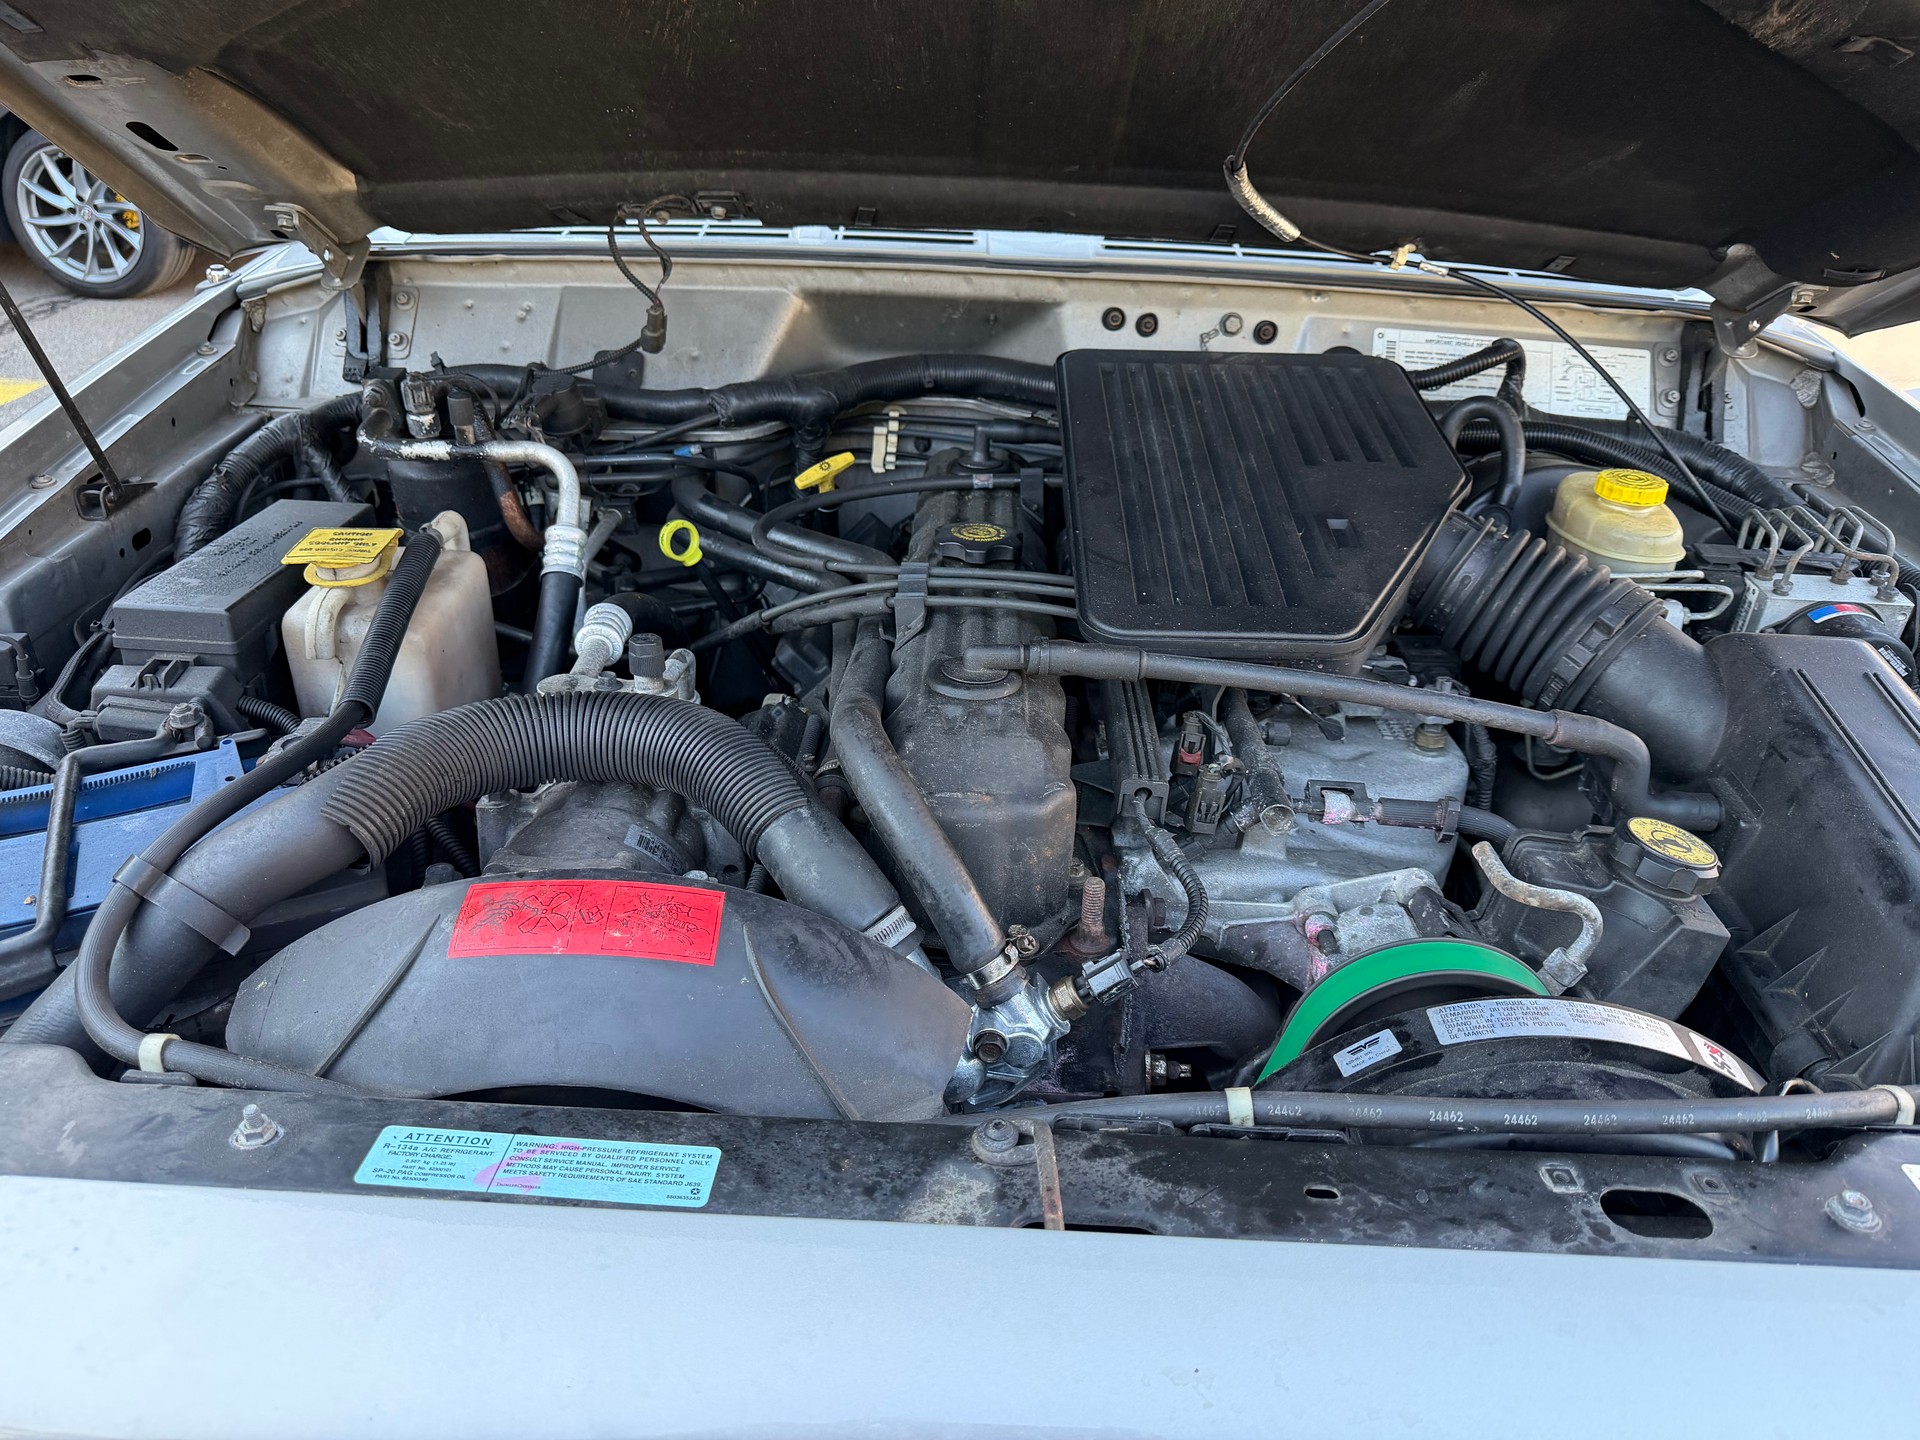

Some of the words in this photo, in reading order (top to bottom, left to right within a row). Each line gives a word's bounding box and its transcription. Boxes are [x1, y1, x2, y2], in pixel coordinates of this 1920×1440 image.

[1445, 1021, 1472, 1029] QUAND
[1464, 1029, 1495, 1038] MARCHE
[1429, 1110, 1464, 1122] 24462
[1504, 1114, 1538, 1125] 24462
[1584, 1114, 1617, 1126] 24462
[1662, 1114, 1694, 1125] 24462
[404, 1132, 493, 1146] ATTENTION
[383, 1143, 418, 1151] R-134a
[440, 1148, 495, 1156] REFRIGERANT
[388, 1150, 420, 1158] FACTORY
[516, 1141, 558, 1150] WARNING:
[561, 1145, 623, 1153] HIGH-PRESSURE
[626, 1149, 679, 1158] REFRIGERANT
[543, 1158, 574, 1166] SERVICE
[611, 1162, 649, 1170] IMPROPER
[639, 1156, 686, 1165] PERSONNEL
[506, 1162, 541, 1170] METHODS
[585, 1168, 624, 1176] PERSONAL
[558, 1172, 615, 1182] REQUIREMENTS
[644, 1178, 683, 1186] STANDARD
